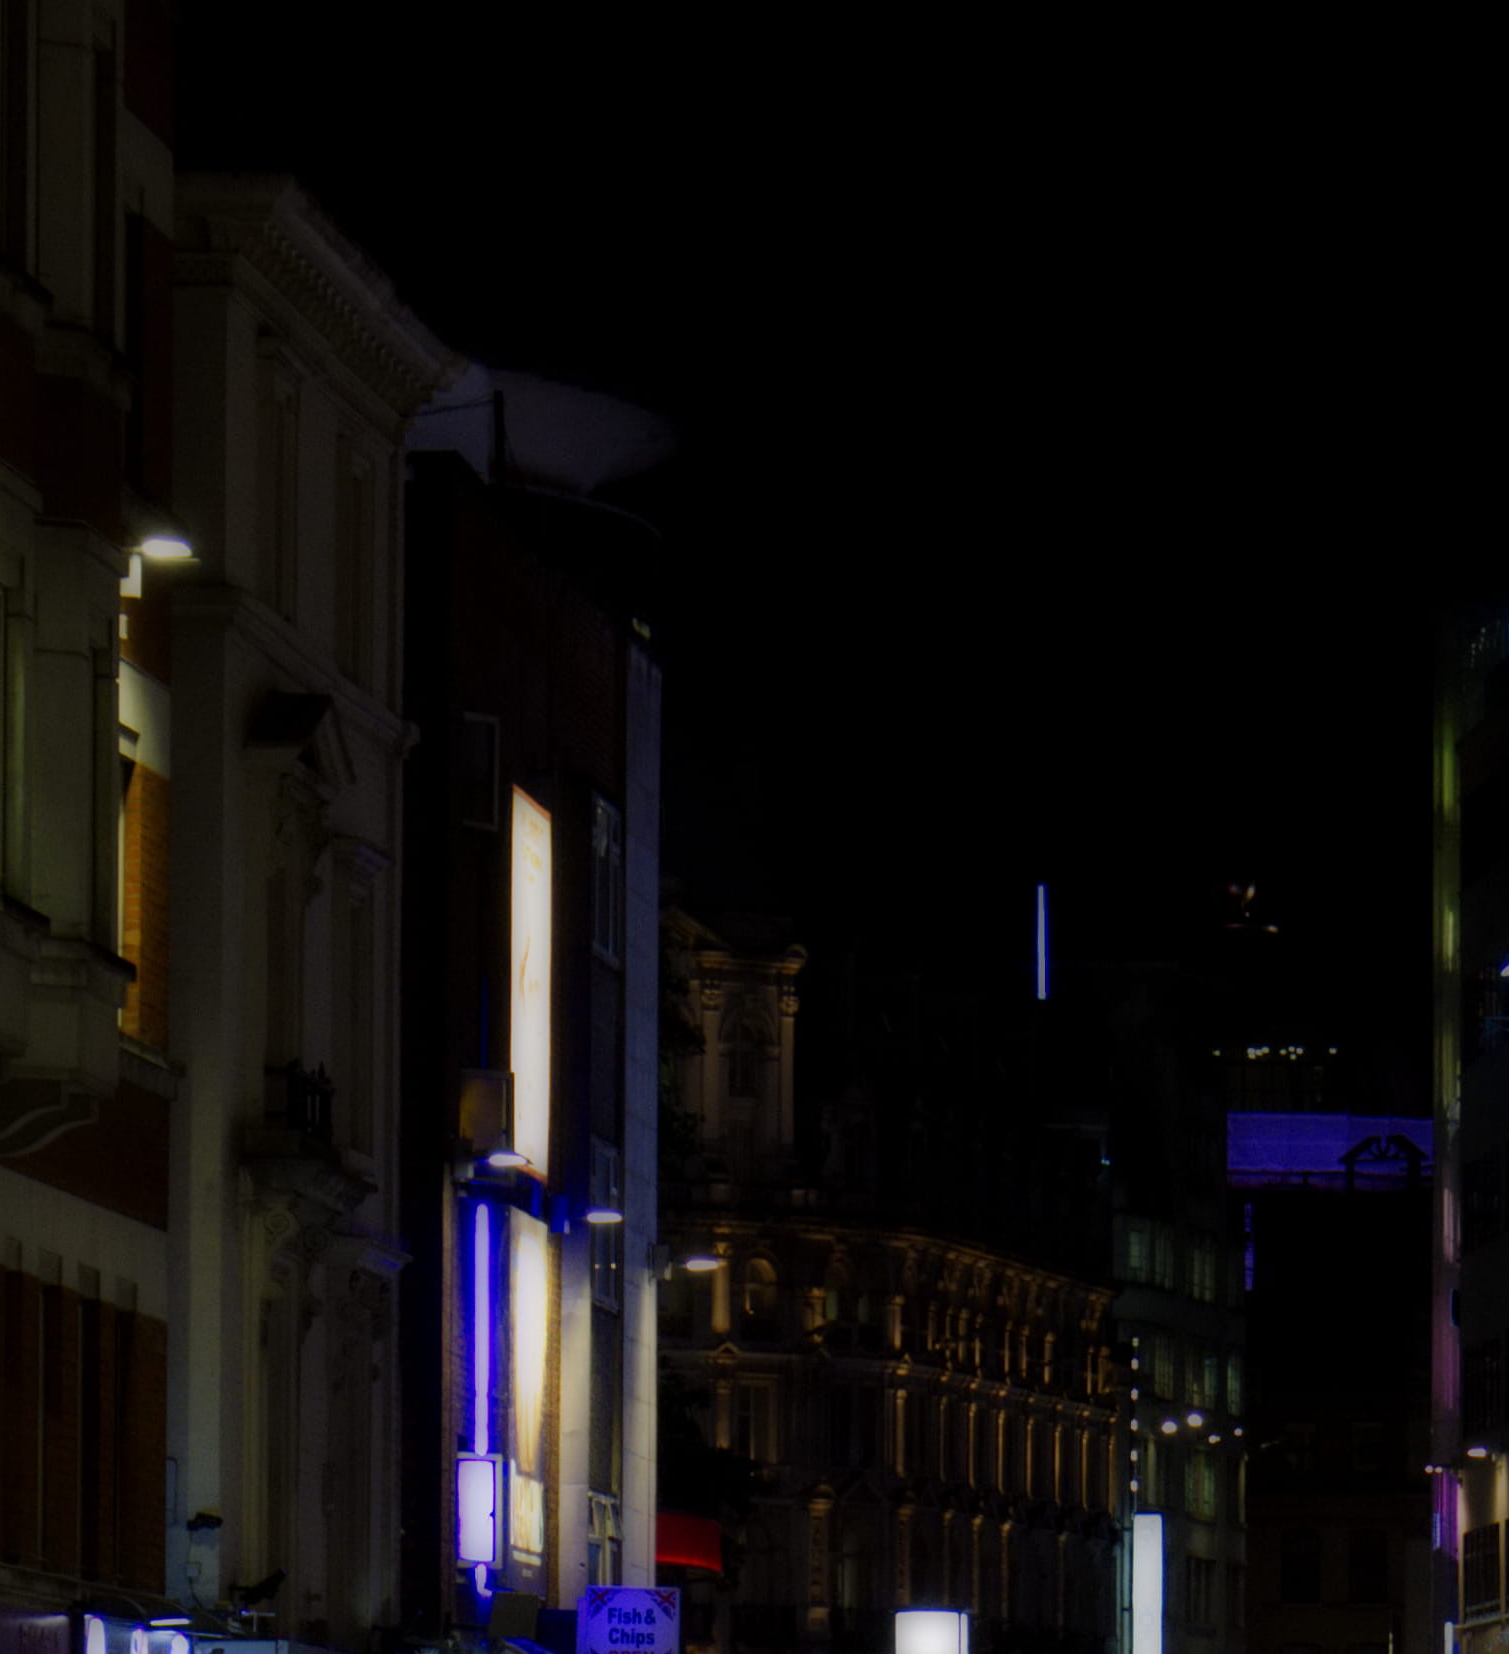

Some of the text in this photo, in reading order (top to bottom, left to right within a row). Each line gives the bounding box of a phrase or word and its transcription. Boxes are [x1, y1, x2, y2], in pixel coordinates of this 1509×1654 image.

[608, 1608, 656, 1625] Fish &
[608, 1627, 655, 1648] Chips
